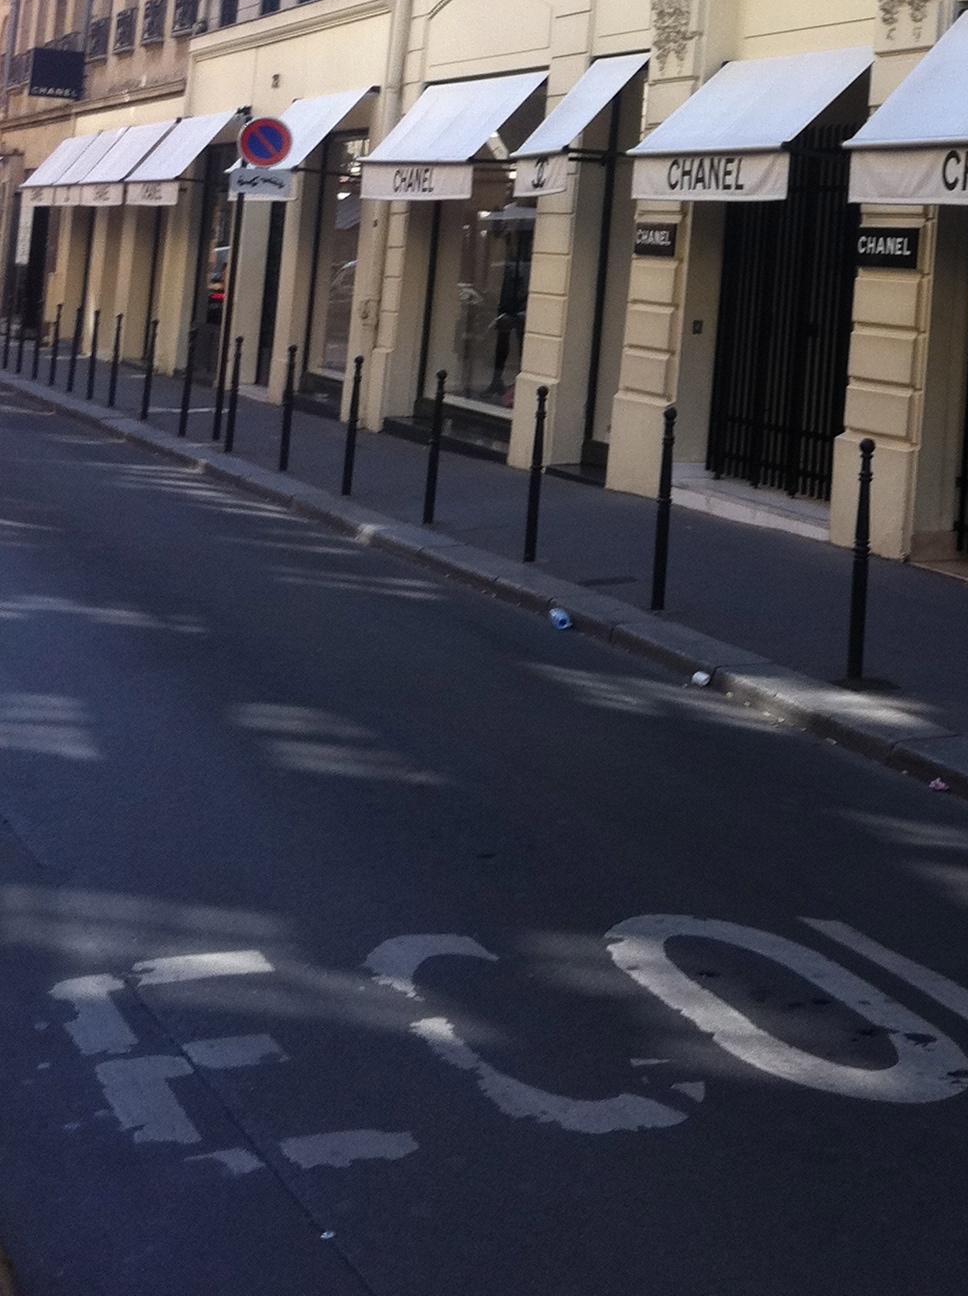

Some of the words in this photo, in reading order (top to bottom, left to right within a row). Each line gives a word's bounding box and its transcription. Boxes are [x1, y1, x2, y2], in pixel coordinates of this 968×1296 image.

[392, 167, 434, 193] CHANEL
[667, 157, 744, 190] CHANEL
[636, 229, 671, 247] CHANEL
[857, 236, 911, 255] CHANEL
